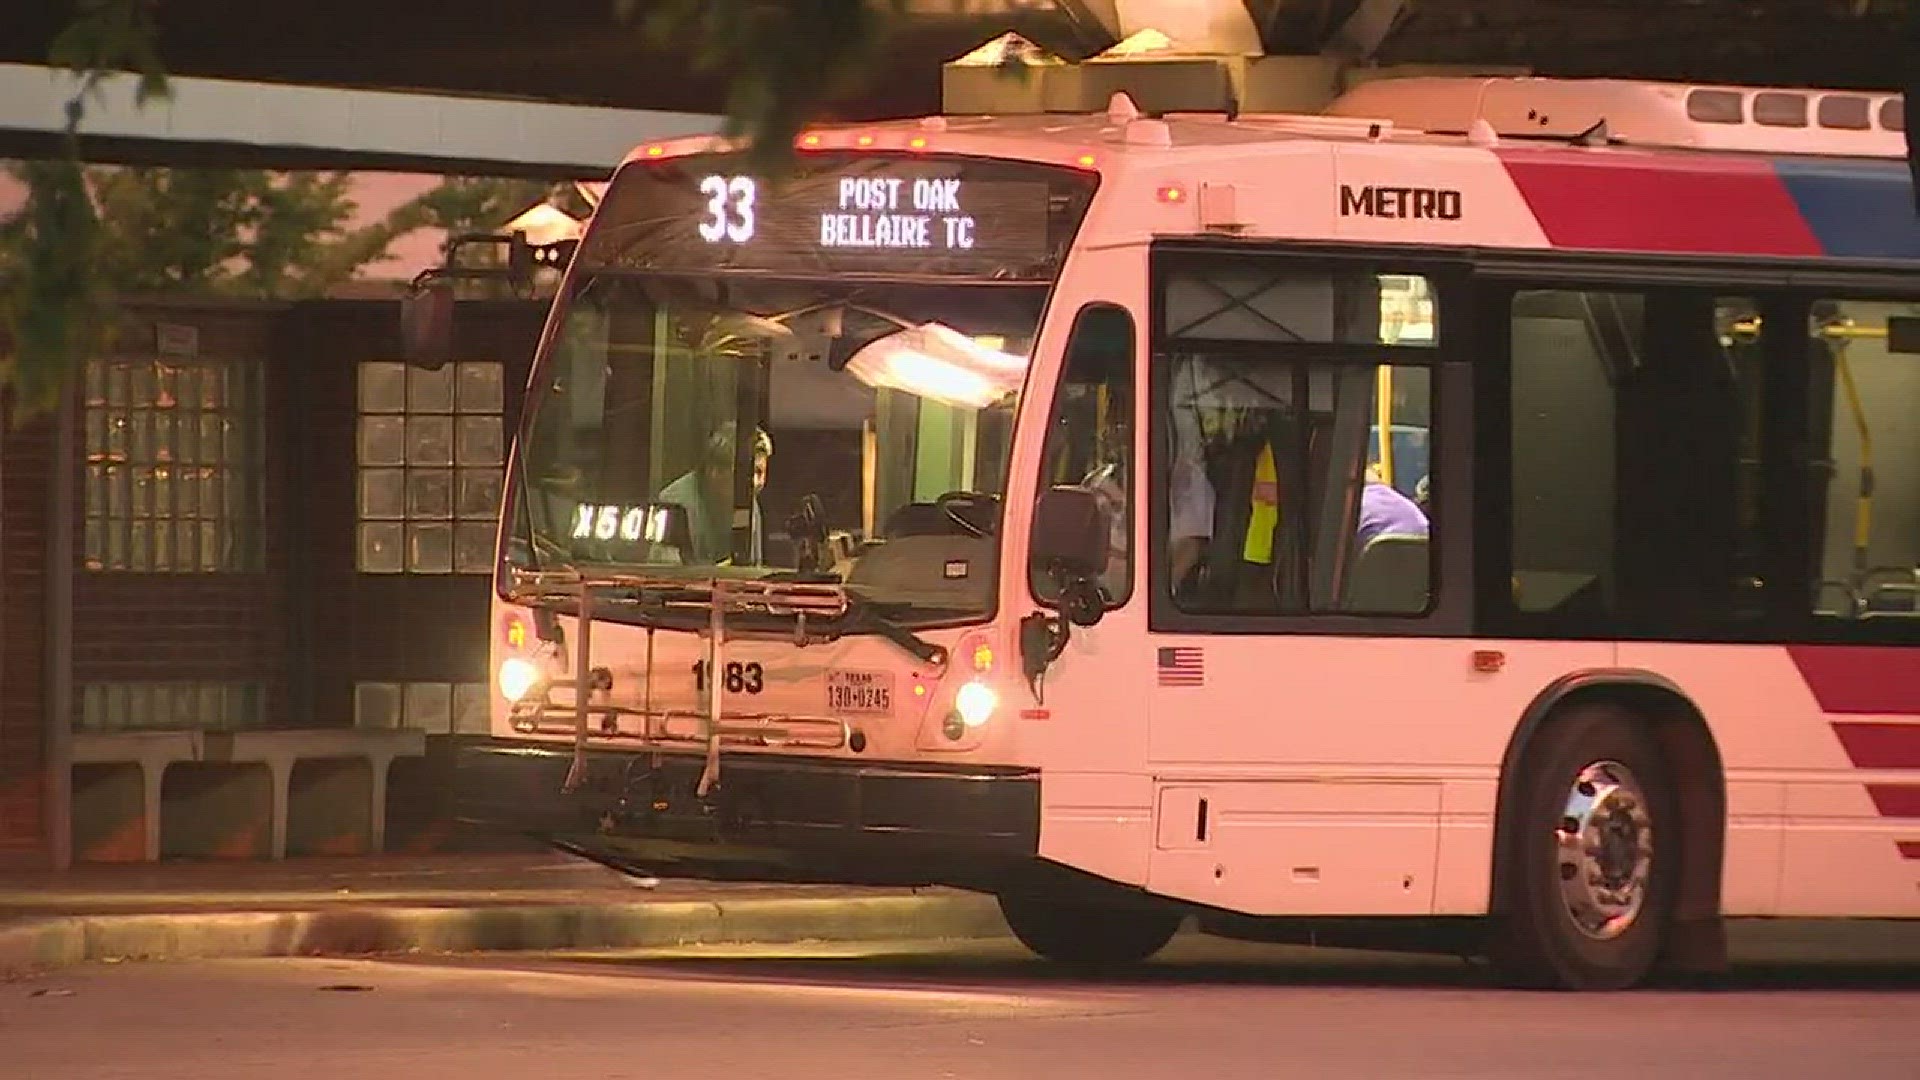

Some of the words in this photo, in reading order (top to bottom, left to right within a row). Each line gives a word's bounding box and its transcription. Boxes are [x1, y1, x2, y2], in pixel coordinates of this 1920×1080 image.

[699, 175, 756, 243] 33
[839, 178, 902, 210] POST
[913, 178, 960, 212] OAK
[1341, 184, 1461, 219] METRO
[820, 213, 931, 248] BELLAIRE
[943, 216, 975, 249] TC
